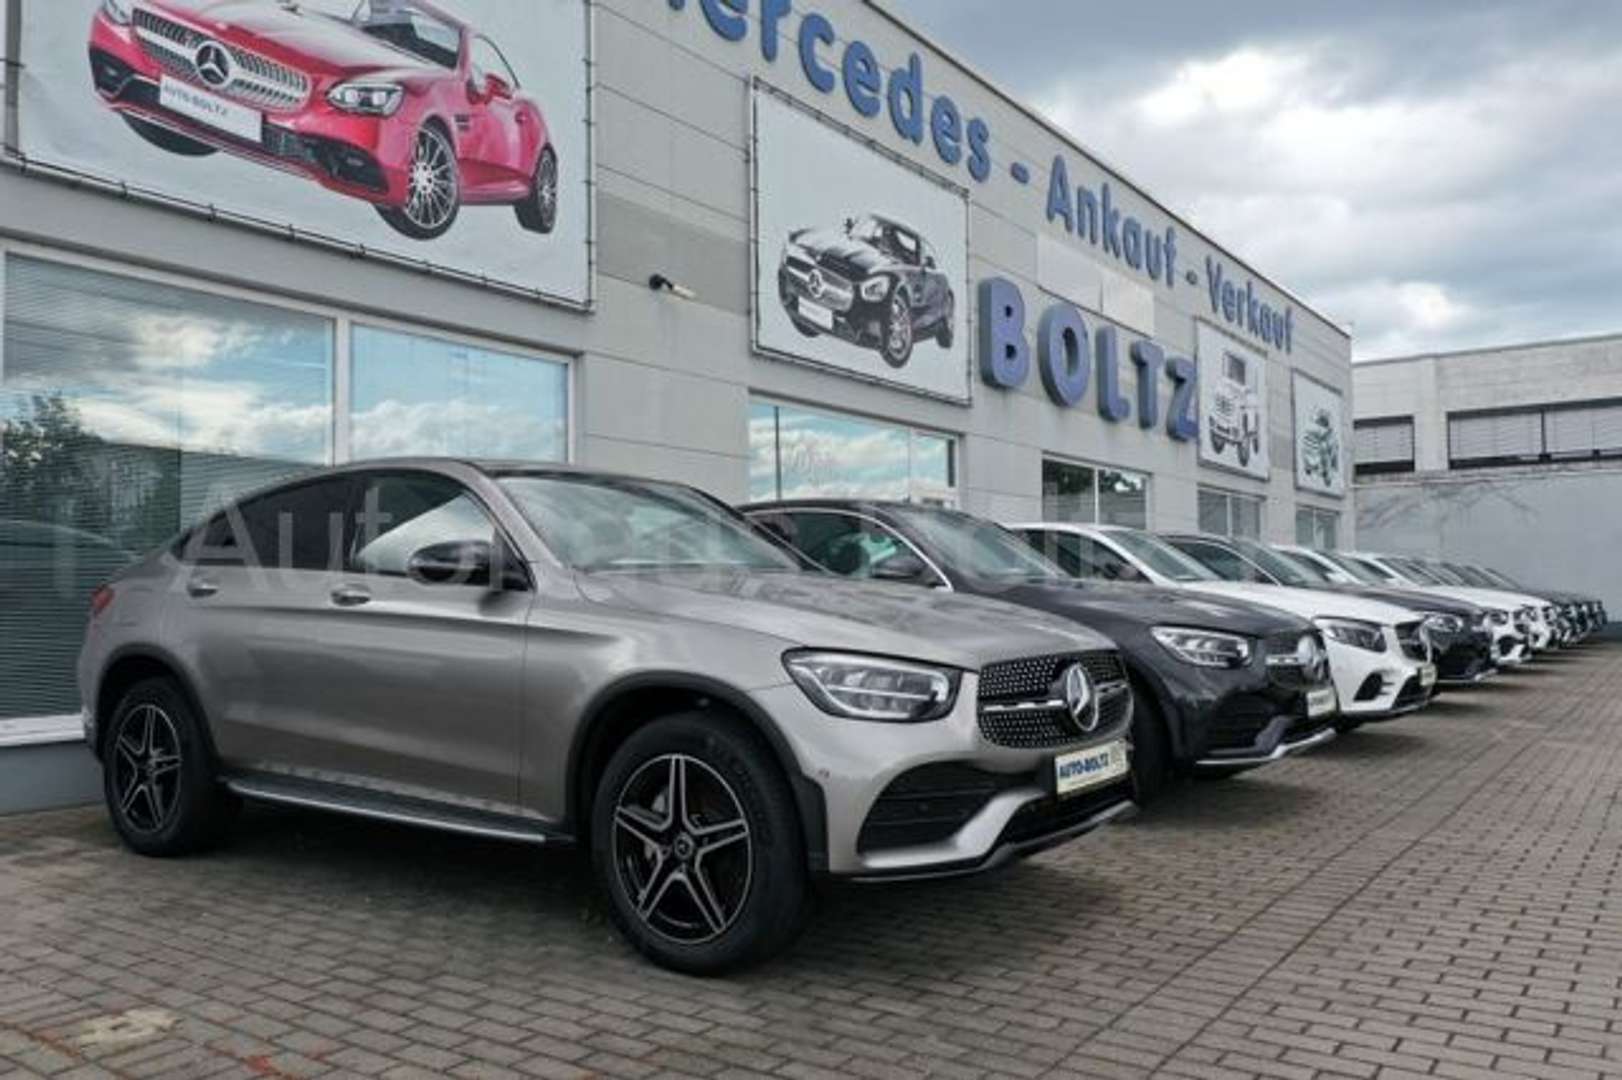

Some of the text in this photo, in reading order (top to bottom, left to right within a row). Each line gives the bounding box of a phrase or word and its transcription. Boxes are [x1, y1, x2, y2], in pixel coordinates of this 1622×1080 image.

[1045, 154, 1178, 288] Ankauf
[1205, 256, 1296, 355] Verkauf
[978, 277, 1198, 442] BOLTZ
